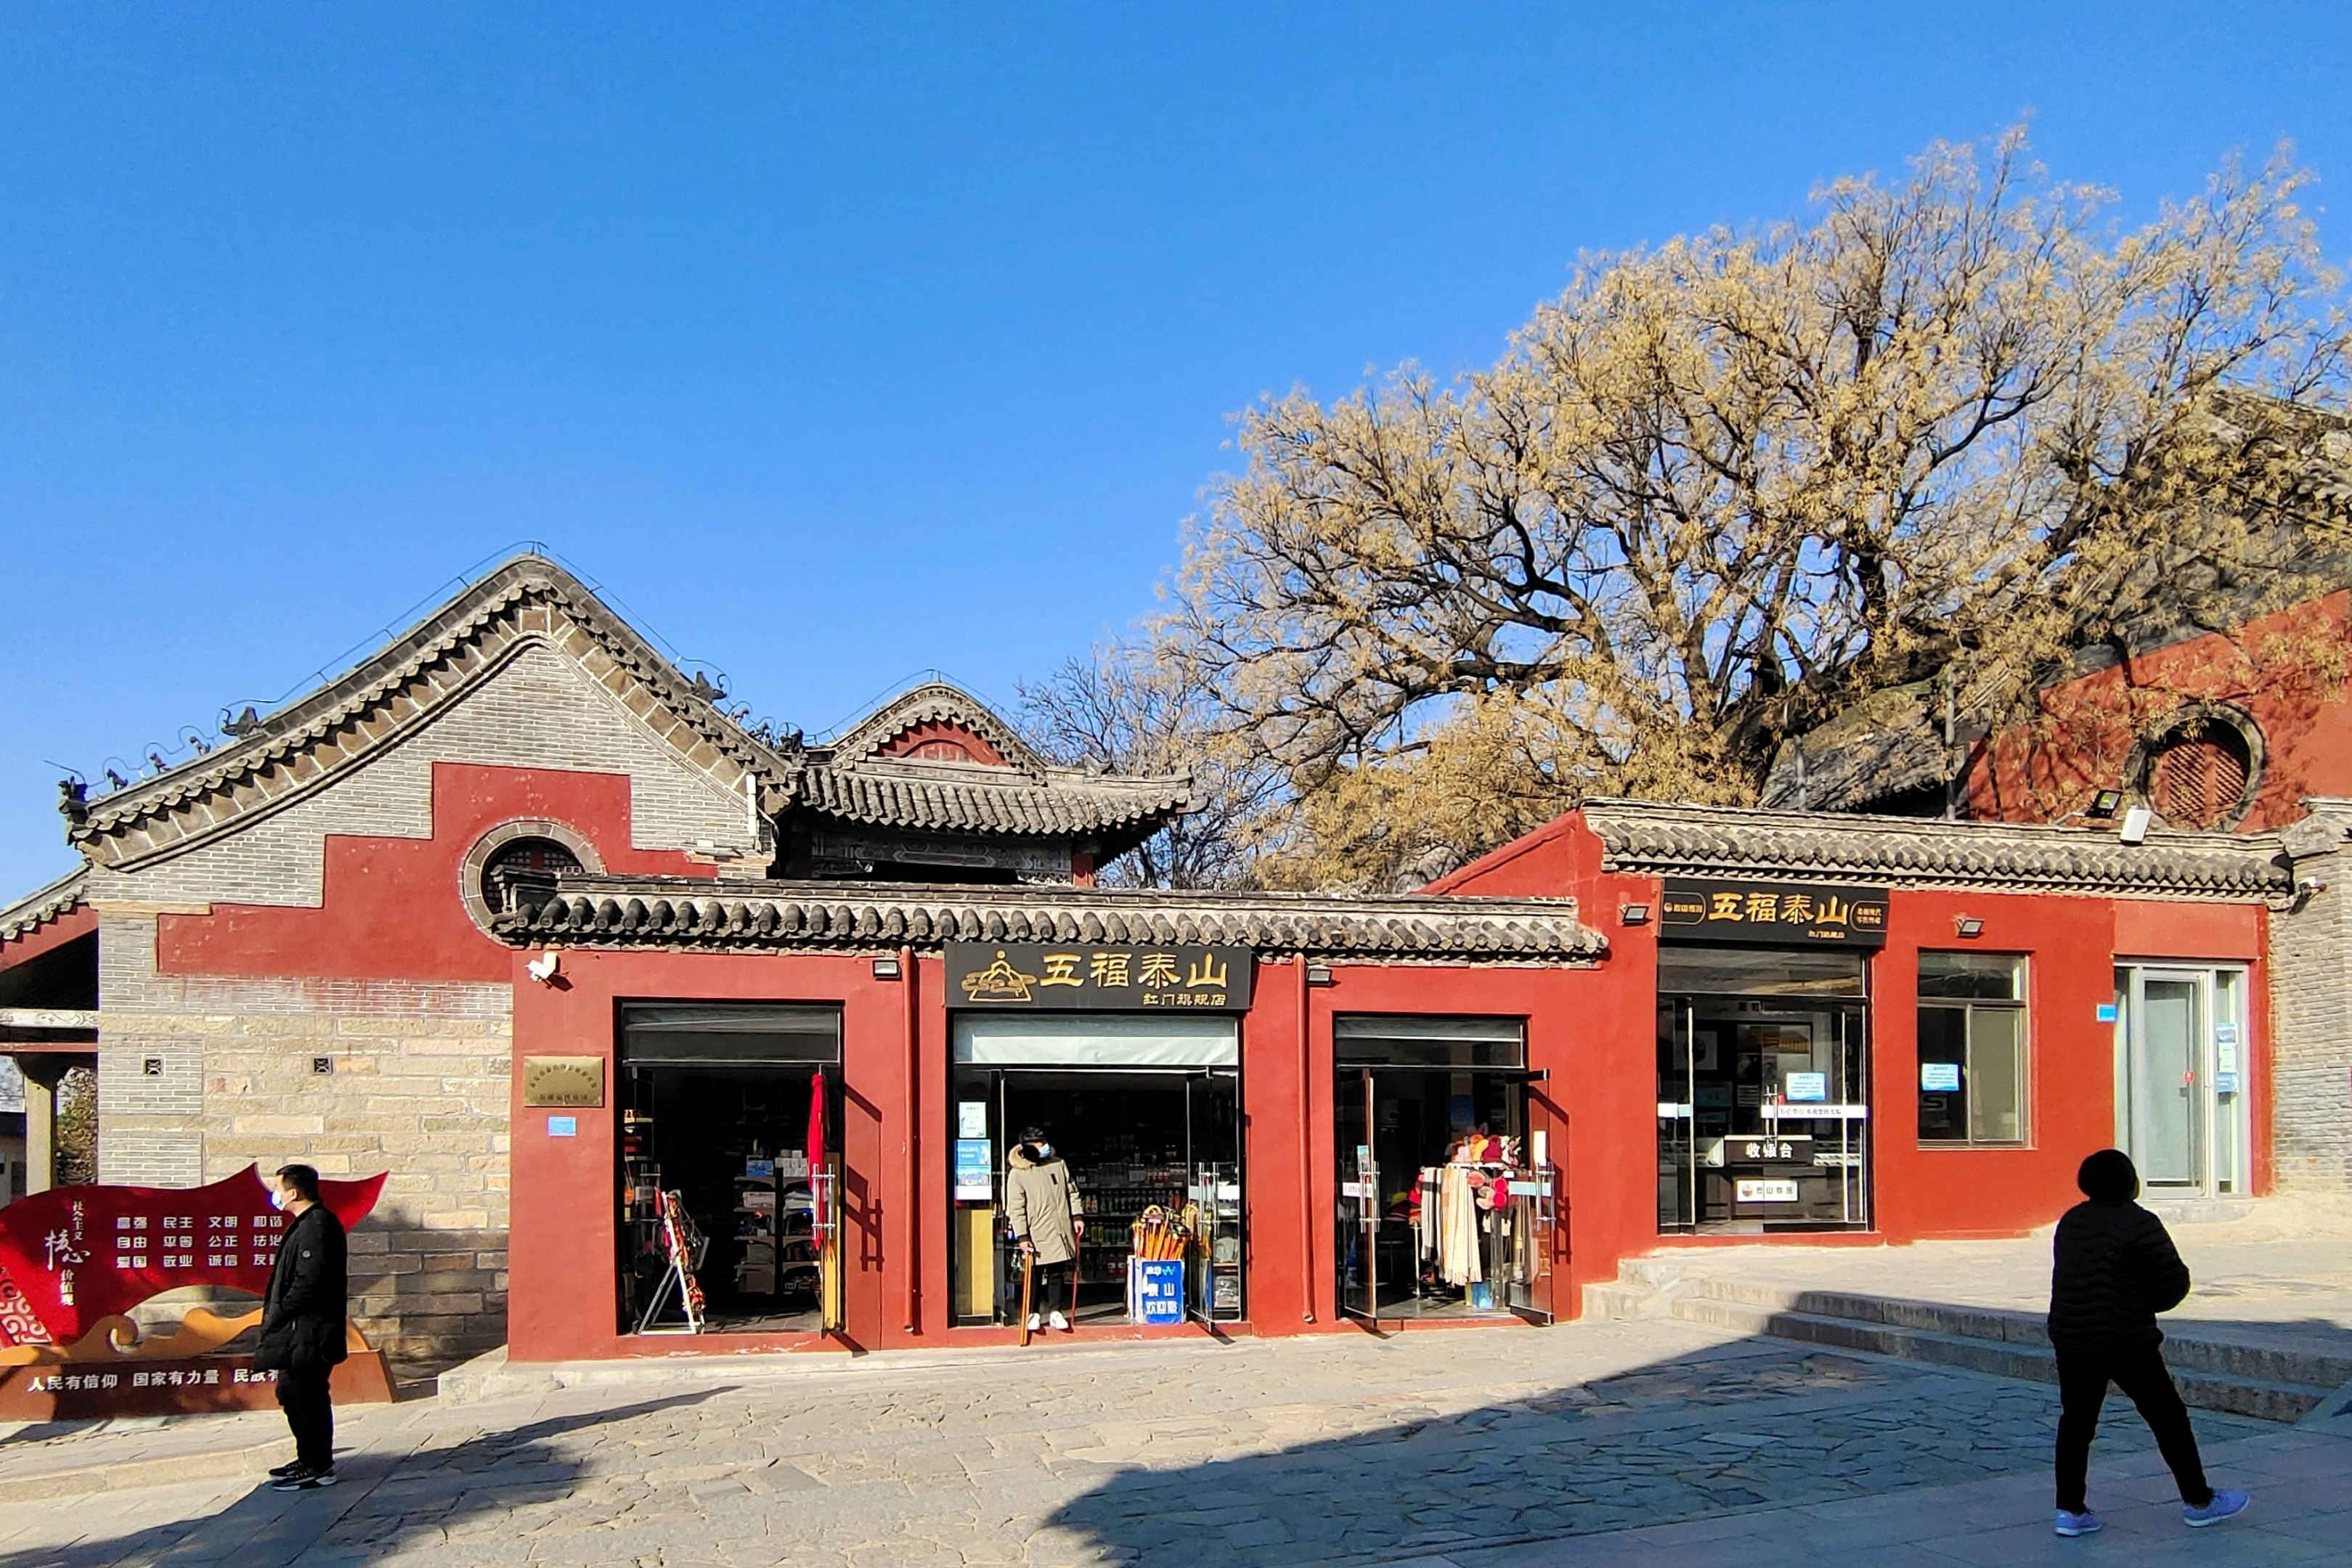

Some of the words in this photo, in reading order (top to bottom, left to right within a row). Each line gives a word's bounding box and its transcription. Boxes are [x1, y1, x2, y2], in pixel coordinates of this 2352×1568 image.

[1708, 892, 1849, 926] 五福泰山
[1039, 952, 1228, 989] 五福泰山
[1142, 992, 1227, 1007] 红门旗舰店
[1745, 1143, 1793, 1159] 收银台
[73, 1201, 84, 1241] 社会主义
[116, 1217, 147, 1229] 富强
[163, 1216, 194, 1228] 民主
[208, 1216, 238, 1228] 文明
[253, 1215, 283, 1228] 和谐
[44, 1228, 91, 1271] 核心
[116, 1236, 147, 1249] 自由
[163, 1236, 193, 1248] 平等
[208, 1235, 238, 1247] 公正
[253, 1234, 282, 1247] 法治
[116, 1255, 147, 1269] 爱国
[163, 1254, 193, 1267] 敬业
[208, 1254, 238, 1267] 诚信
[27, 1373, 118, 1392] 人民有信仰
[132, 1369, 220, 1387] 国家有力量
